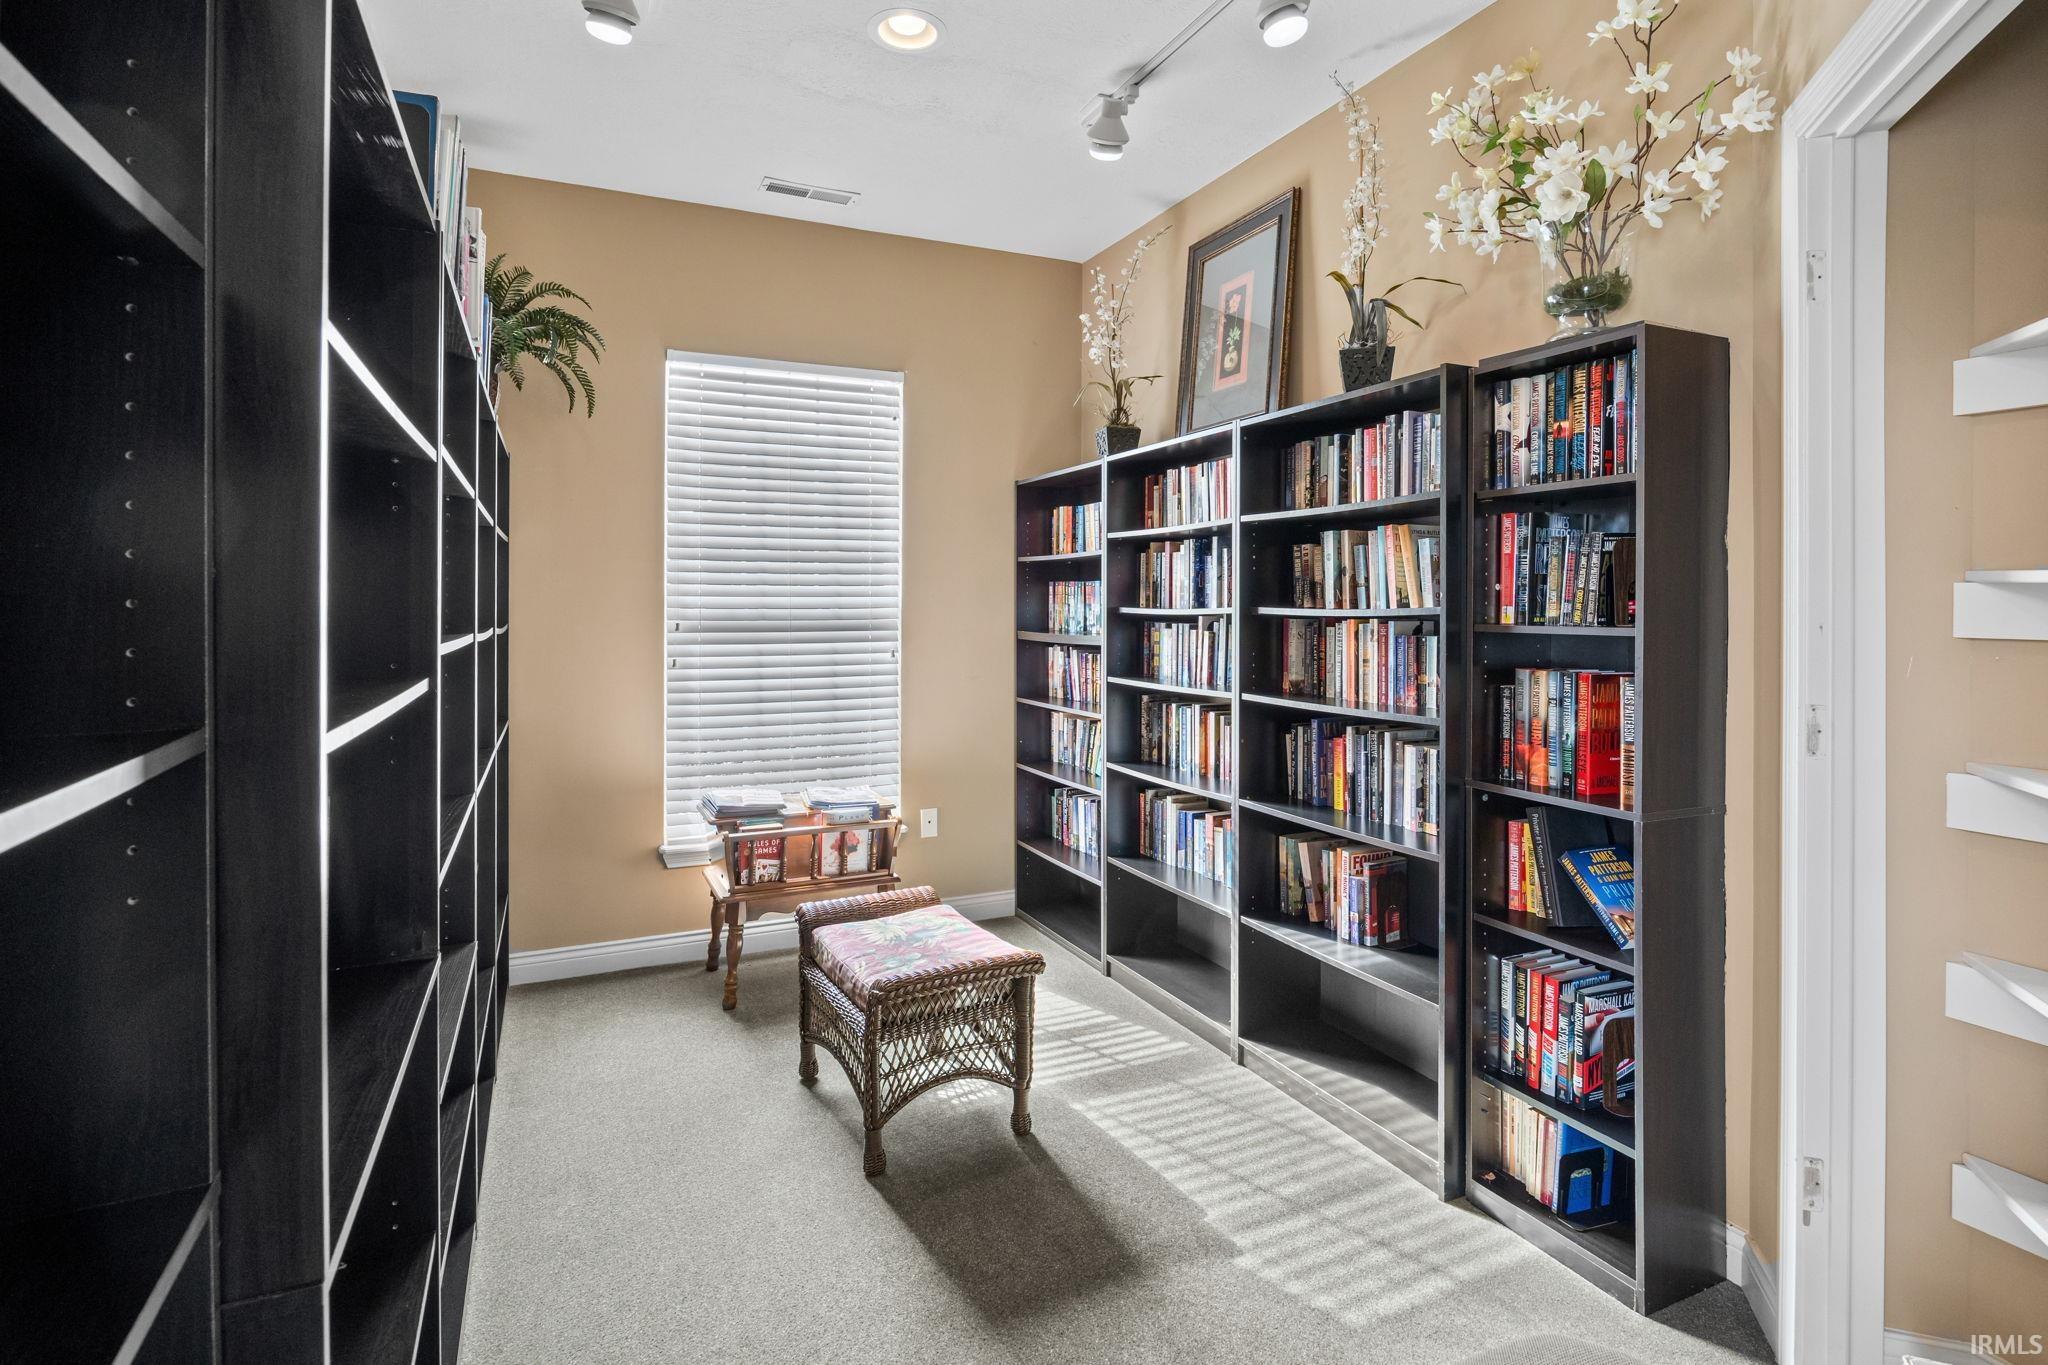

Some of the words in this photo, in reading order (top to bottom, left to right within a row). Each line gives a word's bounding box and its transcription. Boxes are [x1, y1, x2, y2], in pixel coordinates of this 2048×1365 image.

[1531, 381, 1540, 399] JAMES
[1573, 369, 1586, 394] JAMES
[1531, 399, 1540, 428] PATTERSON
[1573, 394, 1586, 434] PATTERSON
[1512, 434, 1520, 454] CROSS
[1530, 430, 1539, 450] CROSS
[1593, 426, 1601, 443] FEAR
[1617, 434, 1625, 447] ALEX
[1530, 450, 1539, 462] THE
[1593, 443, 1600, 454] NO
[1617, 447, 1625, 464] CROSS
[1512, 454, 1520, 477] JUSTICE
[1530, 462, 1539, 476] LINE
[1552, 515, 1570, 529] JAMES
[1578, 568, 1587, 588] PATTERSON
[1589, 567, 1599, 591] PATTERSON
[1575, 588, 1584, 603] CROSS
[1573, 610, 1582, 624] HEART
[1532, 675, 1541, 691] JAMES
[1563, 675, 1572, 697] JAMES
[1578, 680, 1588, 699] JAMES
[1624, 682, 1635, 706] JAMES
[1503, 697, 1511, 715] JAMES
[1532, 690, 1541, 718] PATTERSON
[1503, 714, 1511, 739] PATTERSON
[1563, 697, 1572, 734] PATTERSON
[1578, 699, 1588, 732] PATTERSON
[1624, 705, 1635, 742] PATTERSON
[1531, 719, 1543, 747] BURN
[1370, 732, 1378, 758] RESOLVE
[1623, 748, 1635, 788] AMBUSH
[753, 846, 777, 855] GAMES
[1510, 843, 1519, 860] JAMES
[1589, 850, 1617, 863] JAMES
[1510, 860, 1520, 891] PATTERSON
[1587, 860, 1633, 877] PATTERSON
[1561, 857, 1578, 876] JAMES
[1574, 873, 1598, 905] PATTERSON
[1516, 970, 1526, 990] JAMES
[1501, 981, 1510, 1010] PATTERSON
[1545, 982, 1555, 1001] JAMES
[1516, 989, 1526, 1018] PATTERSON
[1588, 994, 1622, 1013] MARSHALL
[1544, 1000, 1555, 1031] PATTERSON
[1559, 1013, 1569, 1035] JAMES
[1574, 1001, 1584, 1037] MARSHALL
[1515, 1022, 1525, 1046] NYPD
[1528, 1026, 1538, 1051] NYPD
[1543, 1034, 1554, 1055] RED
[1558, 1033, 1569, 1065] PATTERSON
[1574, 1036, 1583, 1056] KARP
[1542, 1050, 1554, 1079] ALERT
